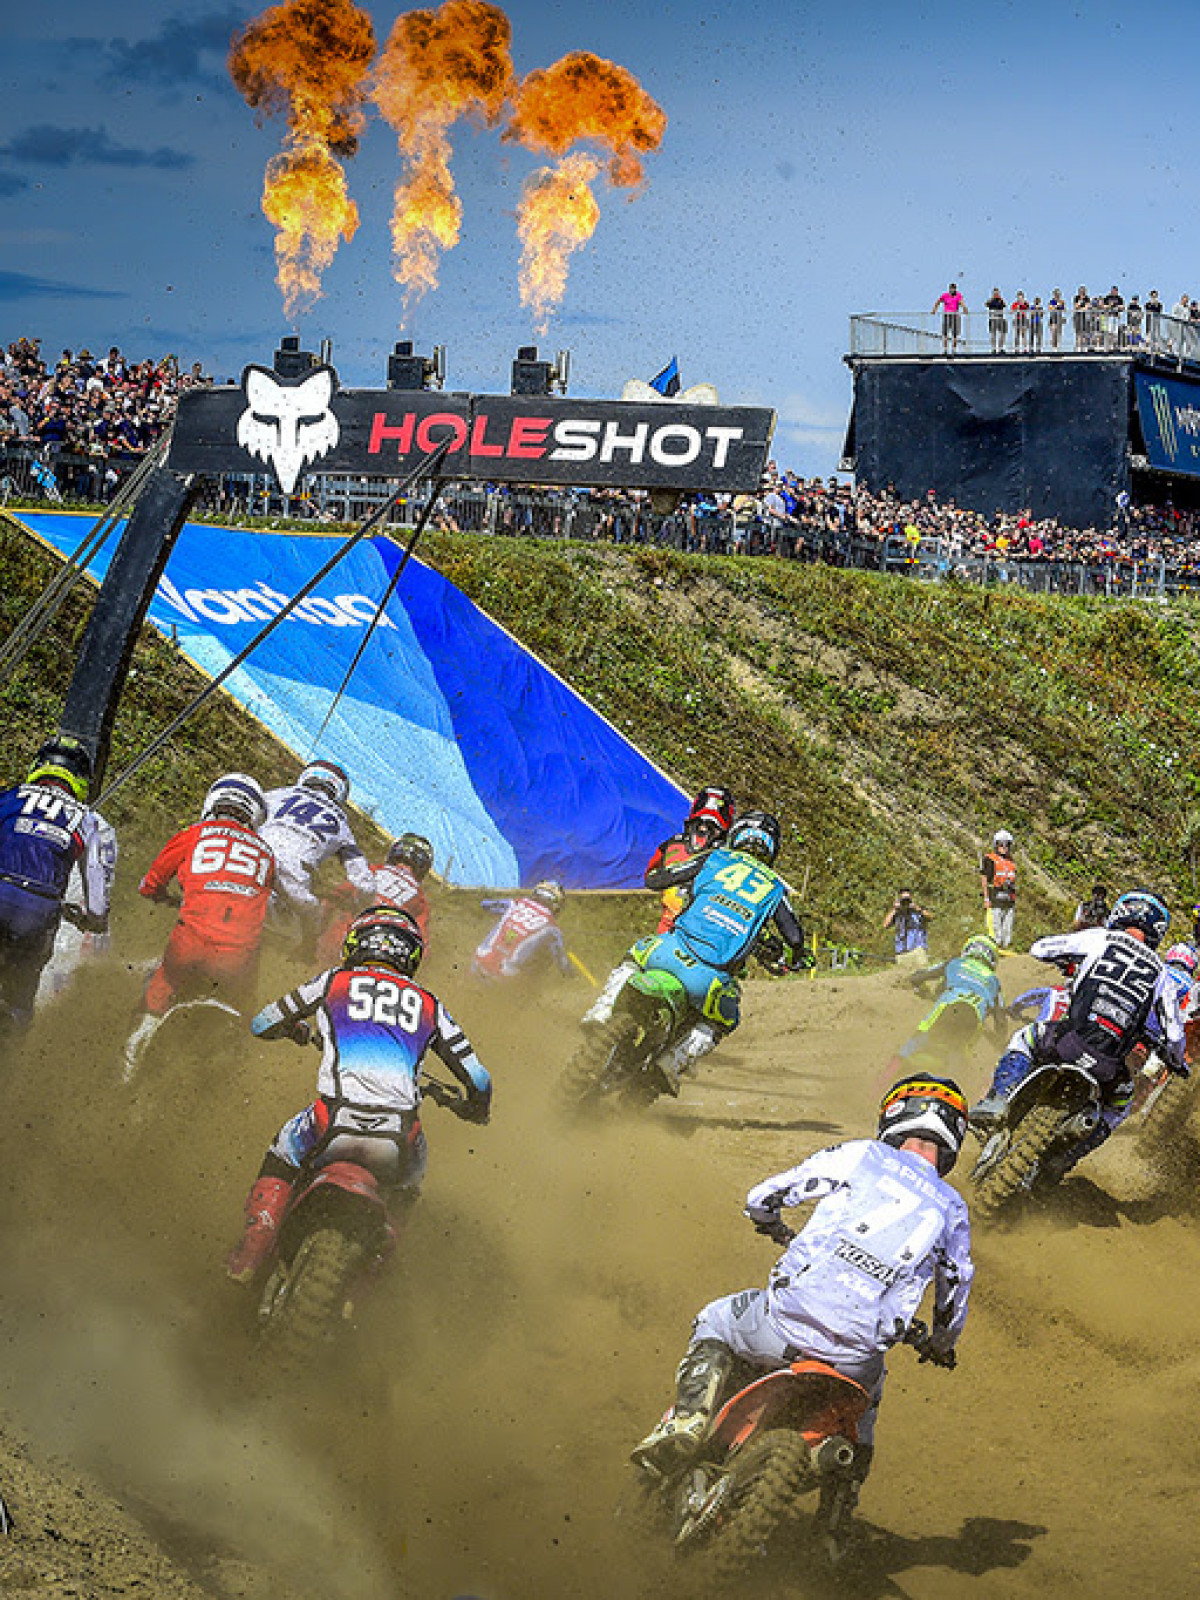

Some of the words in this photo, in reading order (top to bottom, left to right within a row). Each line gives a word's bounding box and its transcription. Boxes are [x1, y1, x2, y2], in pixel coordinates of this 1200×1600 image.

[369, 411, 745, 467] HOLESHOT
[714, 862, 775, 904] 43
[1088, 943, 1159, 1003] 52
[347, 976, 423, 1033] 529
[844, 1175, 946, 1265] 71
